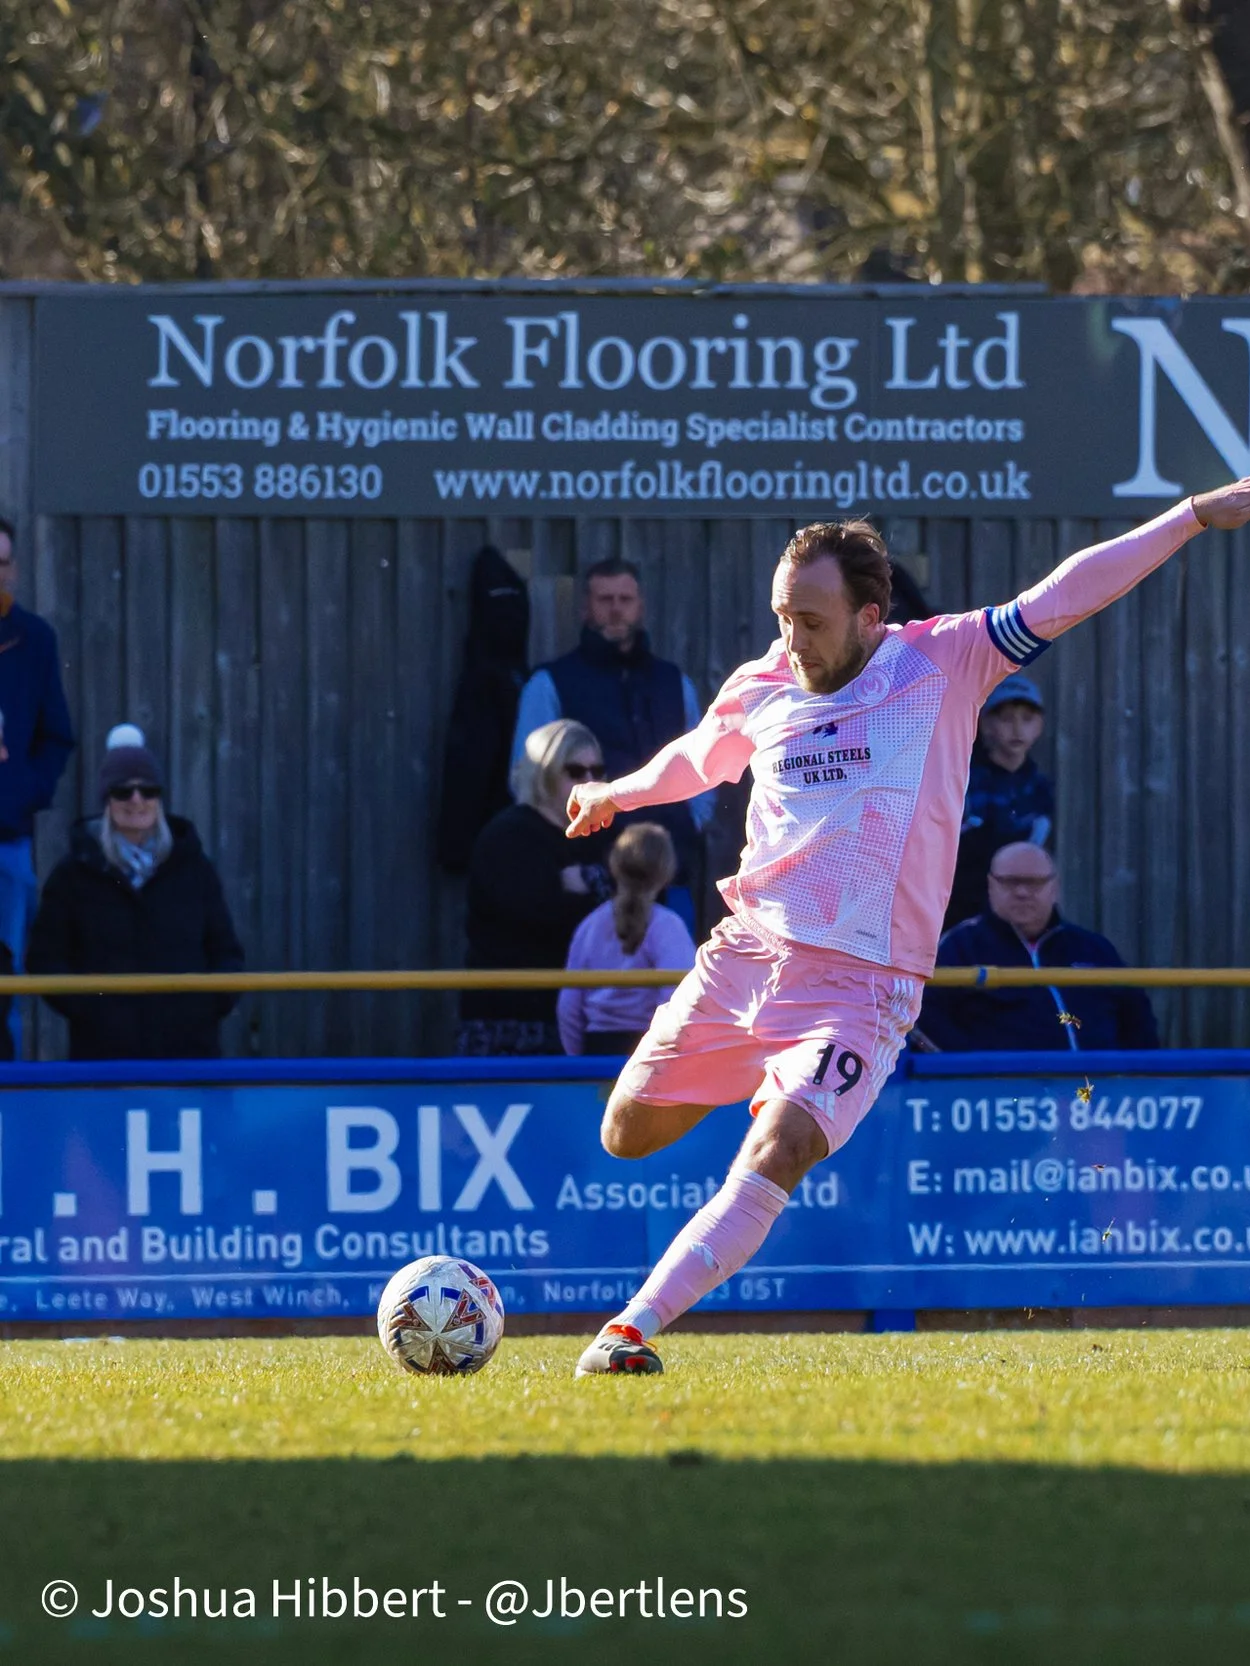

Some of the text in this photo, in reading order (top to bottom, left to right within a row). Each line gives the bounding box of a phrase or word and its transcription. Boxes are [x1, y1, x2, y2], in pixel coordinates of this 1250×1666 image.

[147, 310, 1027, 410] Norfolk Flooring Ltd
[147, 409, 1025, 448] Flooring & Hygienic Wall Cladding Specialist Contractors
[138, 460, 1032, 508] 01553 886130 www.norfolkflooringltd.co.uk
[772, 747, 872, 774] REGIONAL STEELS
[803, 767, 848, 785] UK LTD.
[812, 1043, 863, 1097] 19
[907, 1096, 1204, 1133] T: 01553 844077
[126, 1109, 202, 1216] H
[325, 1102, 535, 1214] BIX
[555, 1174, 720, 1211] Associat
[908, 1162, 943, 1194] E:
[58, 1227, 128, 1263] and
[142, 1226, 302, 1268] Building
[315, 1222, 550, 1259] Consultants
[909, 1221, 955, 1256] W:
[36, 1289, 108, 1311] Leete
[192, 1286, 255, 1308] West
